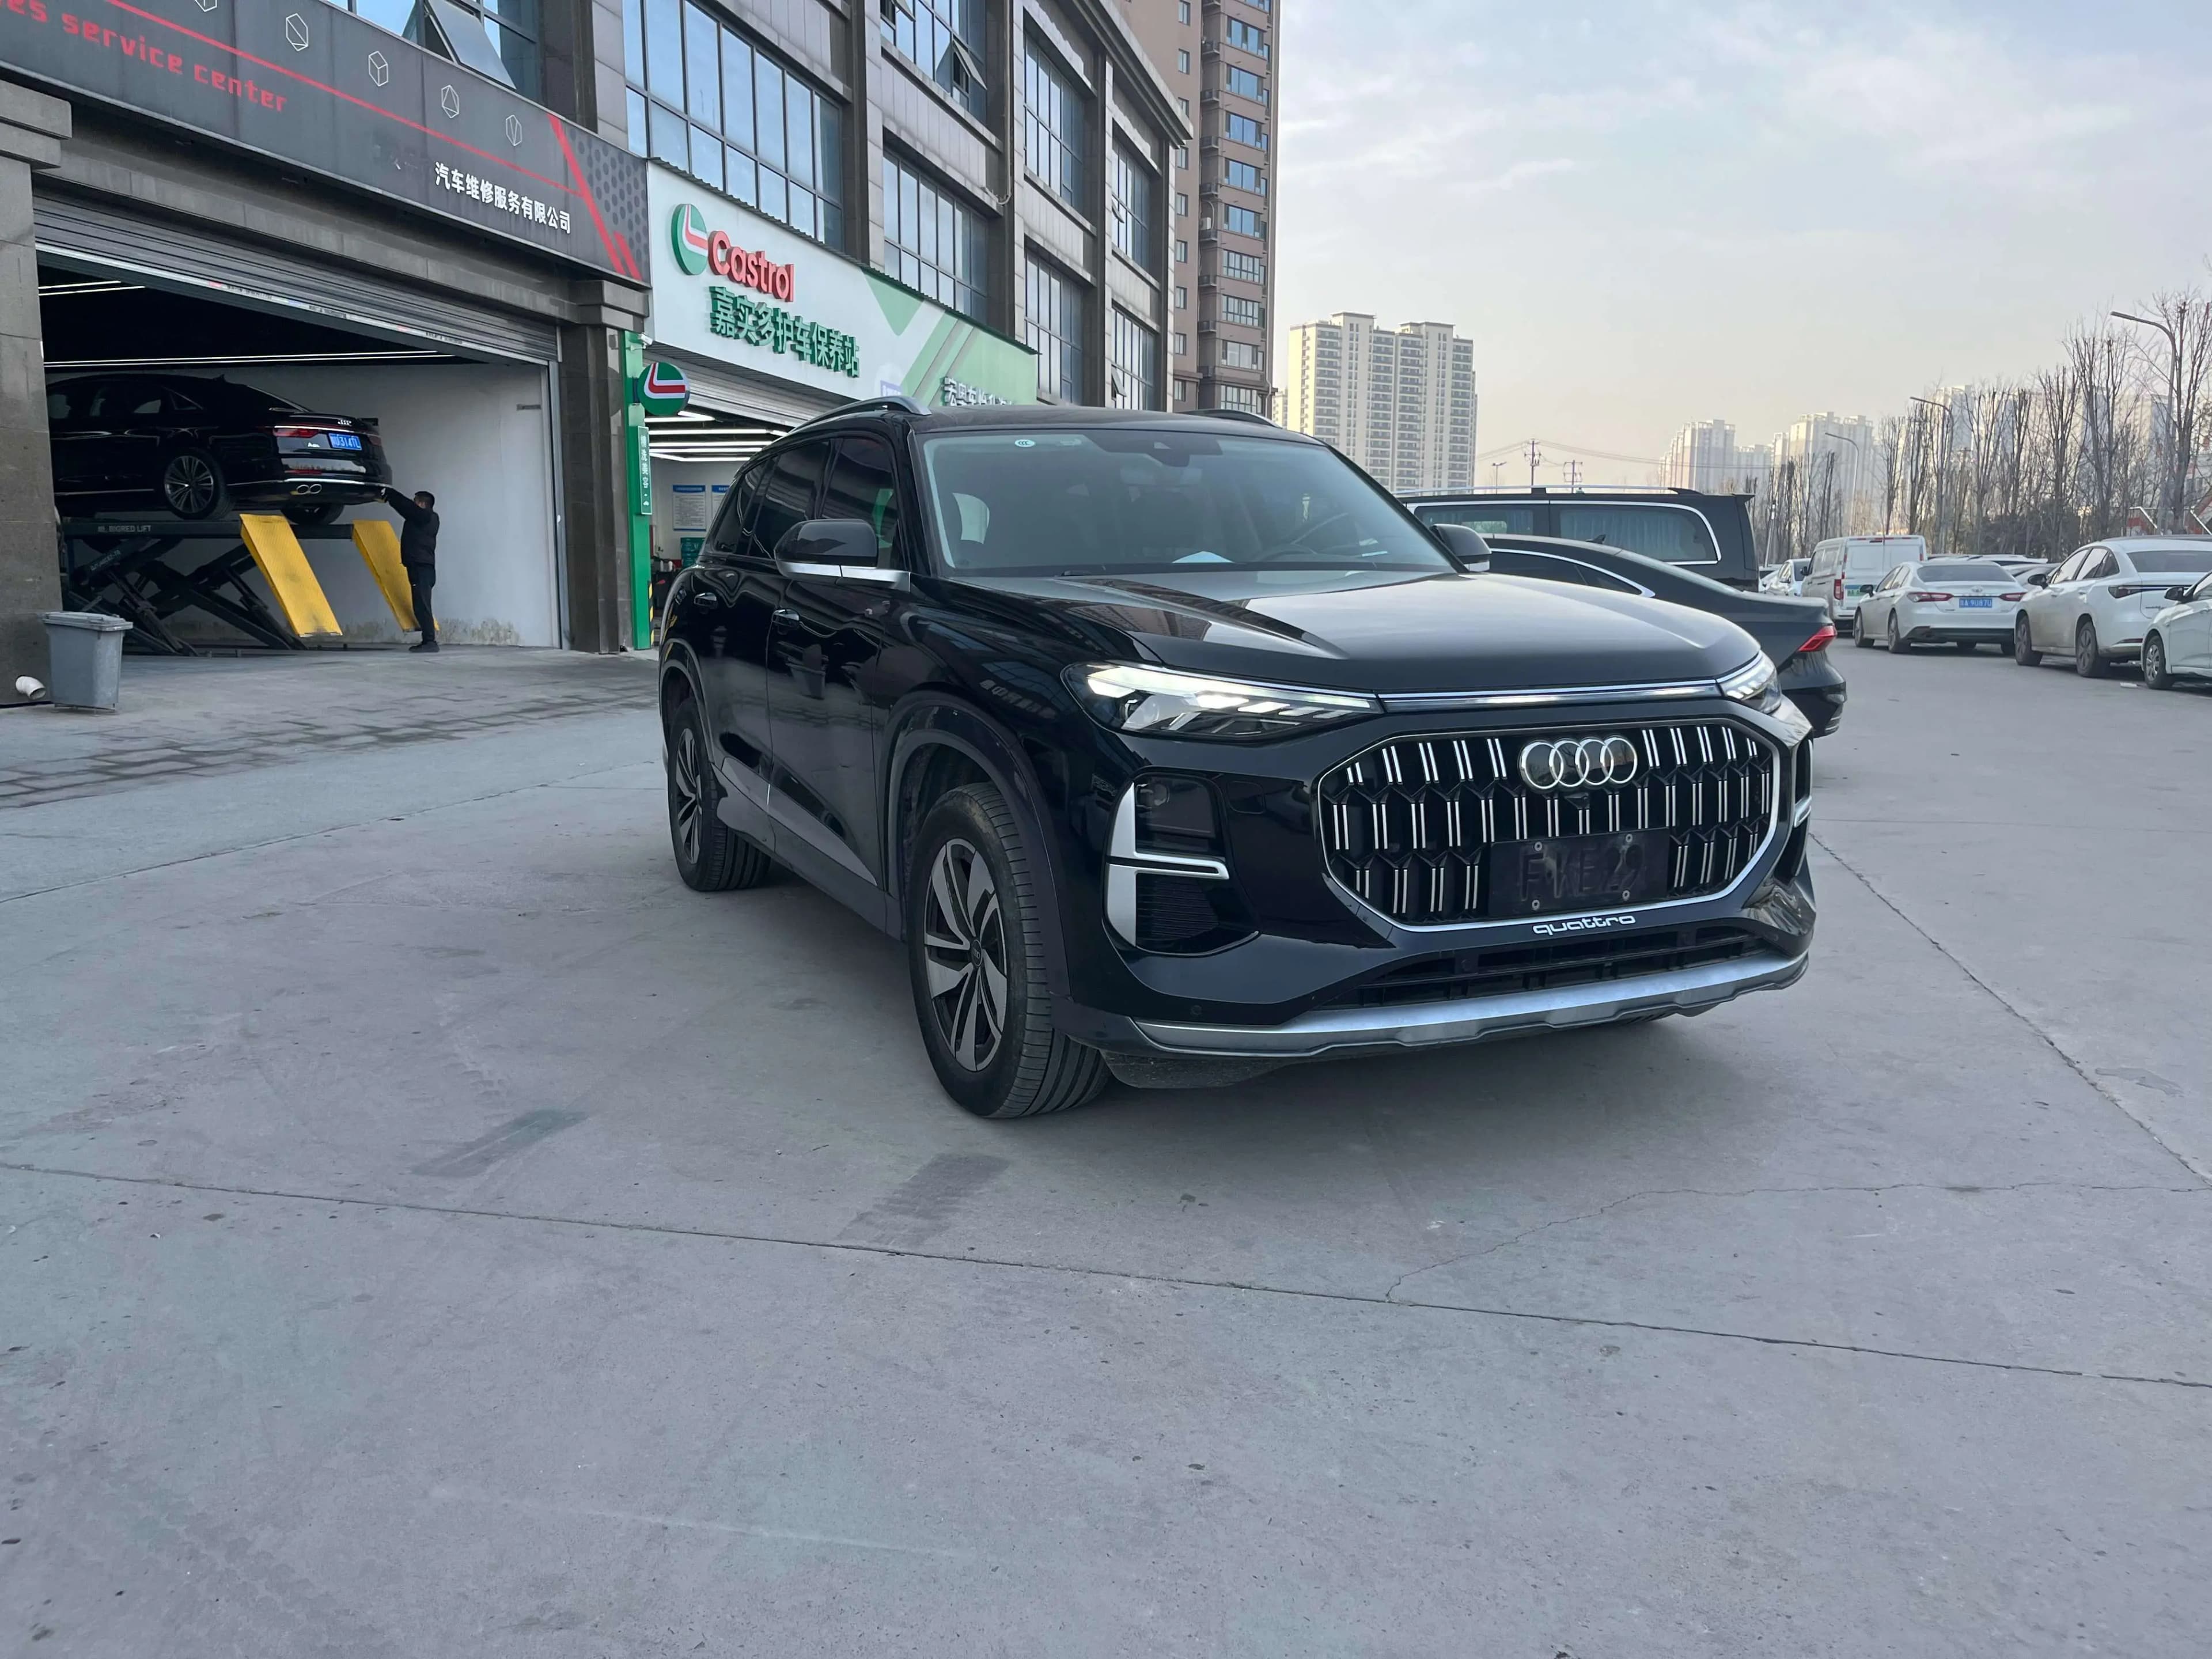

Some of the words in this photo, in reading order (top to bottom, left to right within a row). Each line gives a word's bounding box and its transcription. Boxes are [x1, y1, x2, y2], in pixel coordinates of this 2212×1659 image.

[0, 0, 48, 22] es
[61, 13, 183, 74] service
[194, 64, 286, 112] center
[435, 161, 571, 234] 汽车维修服务有限公司
[708, 230, 794, 302] Castrol
[709, 286, 859, 377] 嘉实多护车保养站
[1533, 915, 1635, 935] quattro
